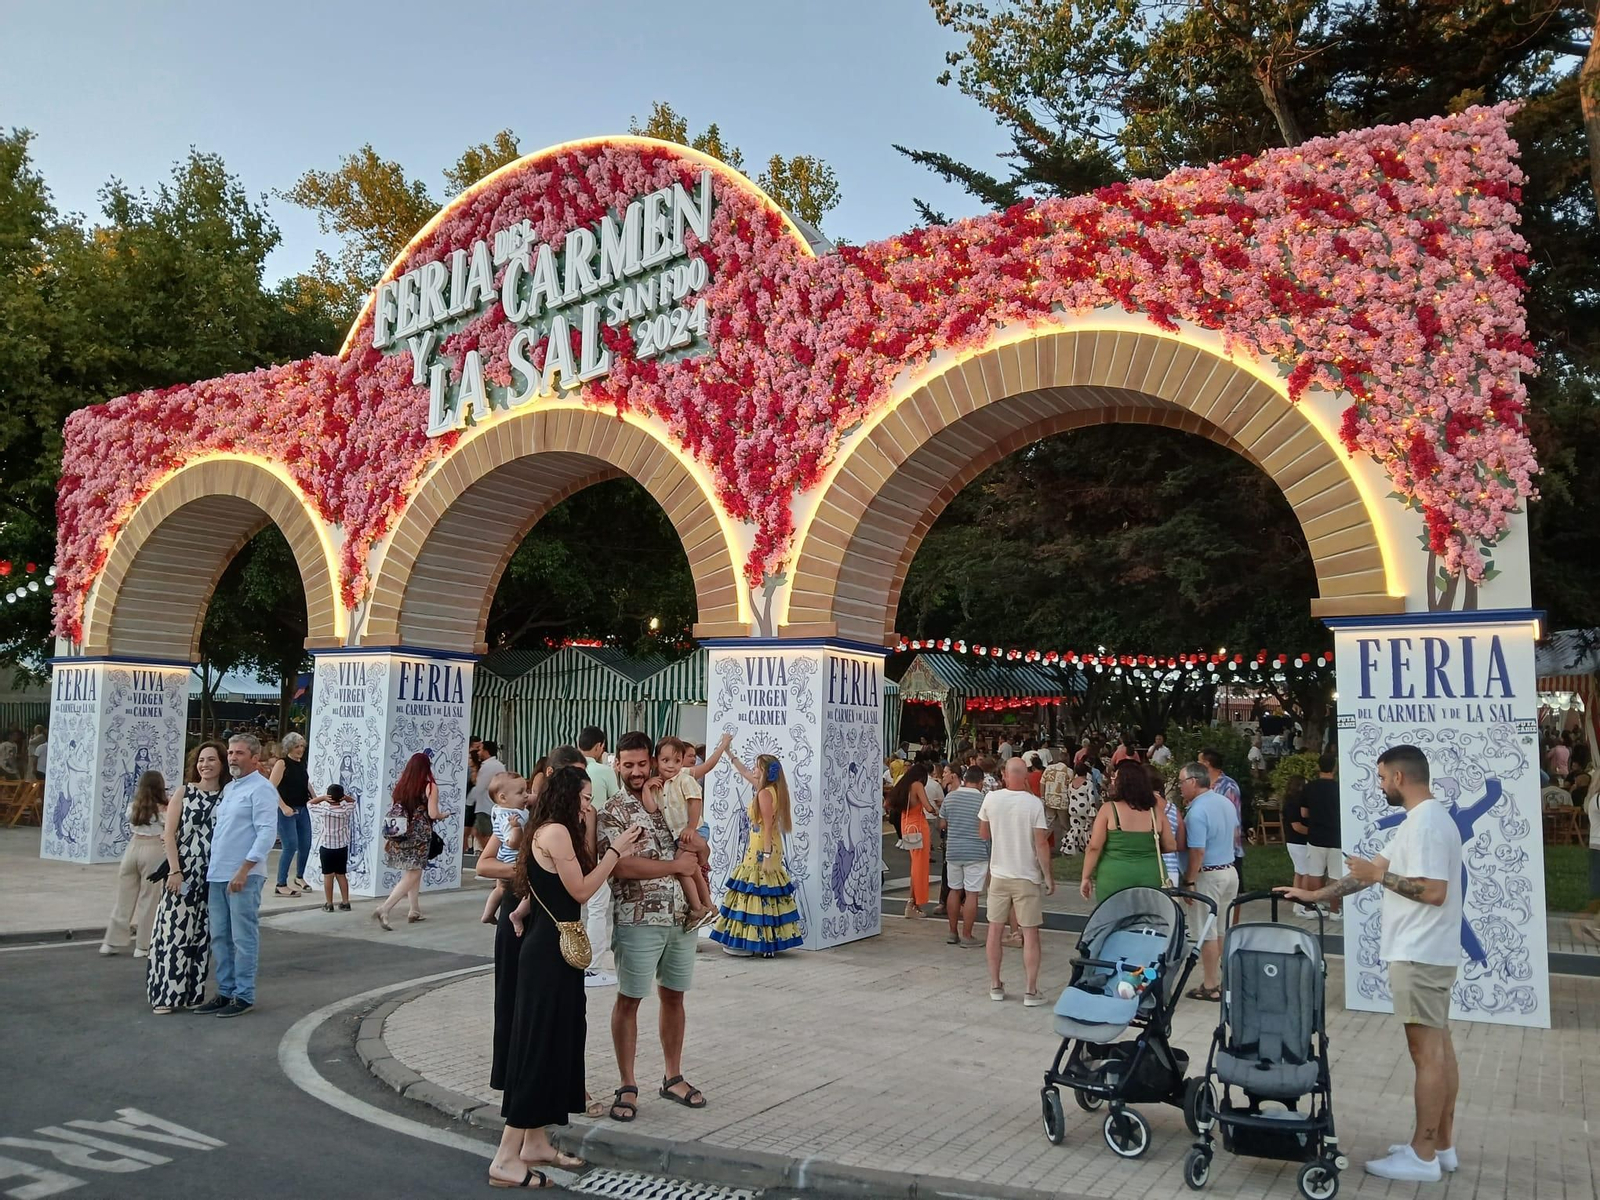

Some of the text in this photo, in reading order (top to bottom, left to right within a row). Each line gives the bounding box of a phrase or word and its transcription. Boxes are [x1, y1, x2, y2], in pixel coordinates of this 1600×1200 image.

[372, 169, 712, 349] FERIA DEL CARMEN
[606, 258, 709, 327] SAN FDO
[636, 297, 709, 360] 2024
[408, 331, 435, 385] Y
[426, 301, 612, 437] LA SAL
[339, 661, 367, 686] VIVA
[745, 656, 788, 687] VIVA
[1356, 634, 1516, 699] FERIA
[56, 668, 97, 701] FERIA
[133, 670, 164, 691] VIVA
[397, 661, 465, 704] FERIA
[828, 656, 879, 708] FERIA
[133, 692, 164, 705] VIRGEN
[339, 688, 366, 703] VIRGEN
[747, 689, 788, 707] VIRGEN
[133, 706, 164, 718] CARMEN
[339, 705, 366, 718] CARMEN
[405, 703, 432, 716] CARMEN
[443, 705, 451, 718] LA
[452, 705, 464, 718] SAL
[738, 709, 787, 726] DEL CARMEN
[835, 708, 855, 723] CARMEN
[1358, 703, 1516, 723] DEL CARMEN Y DE LA SAL
